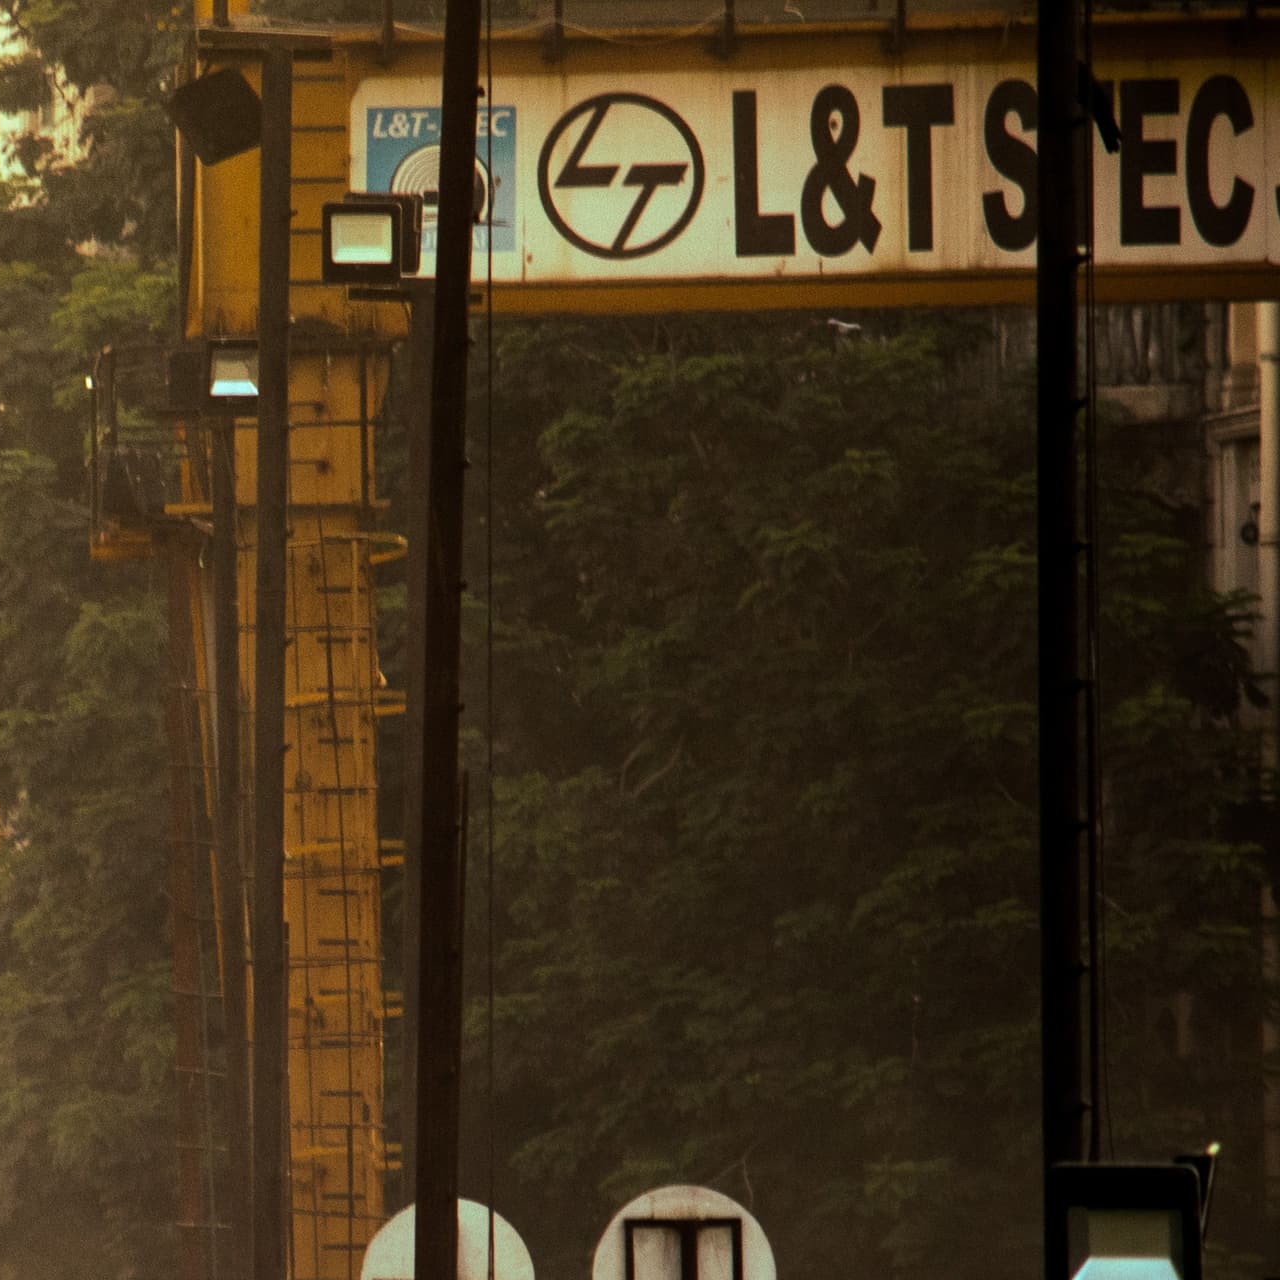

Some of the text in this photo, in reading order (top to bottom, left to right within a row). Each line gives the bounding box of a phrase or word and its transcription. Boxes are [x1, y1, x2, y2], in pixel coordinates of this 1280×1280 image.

[372, 110, 511, 139] L&T-EC
[732, 74, 1256, 258] L&T SEC
